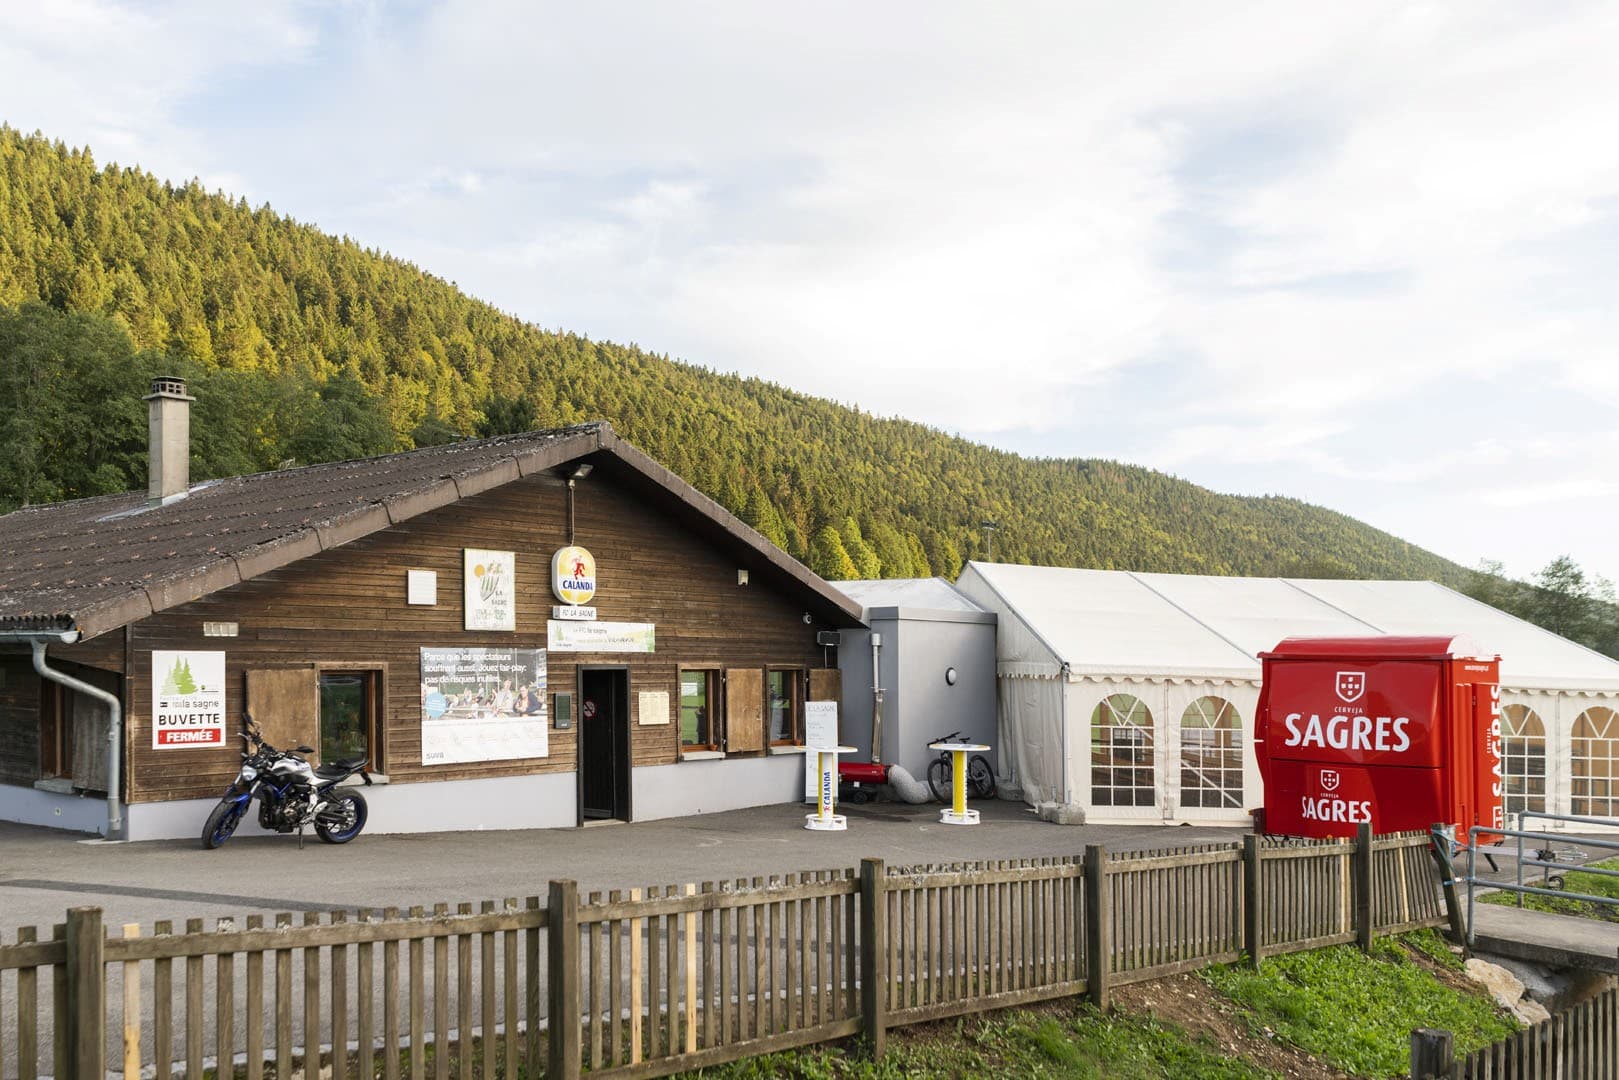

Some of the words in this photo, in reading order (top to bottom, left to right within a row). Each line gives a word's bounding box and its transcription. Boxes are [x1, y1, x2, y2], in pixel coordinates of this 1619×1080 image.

[424, 652, 444, 661] Parce
[446, 654, 459, 662] que
[461, 652, 471, 661] les
[478, 663, 498, 672] Jouez
[424, 676, 438, 684] pas
[440, 675, 449, 683] de
[450, 675, 475, 684] risques
[193, 700, 219, 709] sagne
[1334, 706, 1363, 714] CERVEJA
[159, 713, 220, 725] BUVETTE
[166, 729, 213, 742] FERMÉE
[1284, 713, 1410, 752] SAGRES
[823, 771, 831, 805] CALANDA
[1301, 796, 1372, 824] SAGRES
